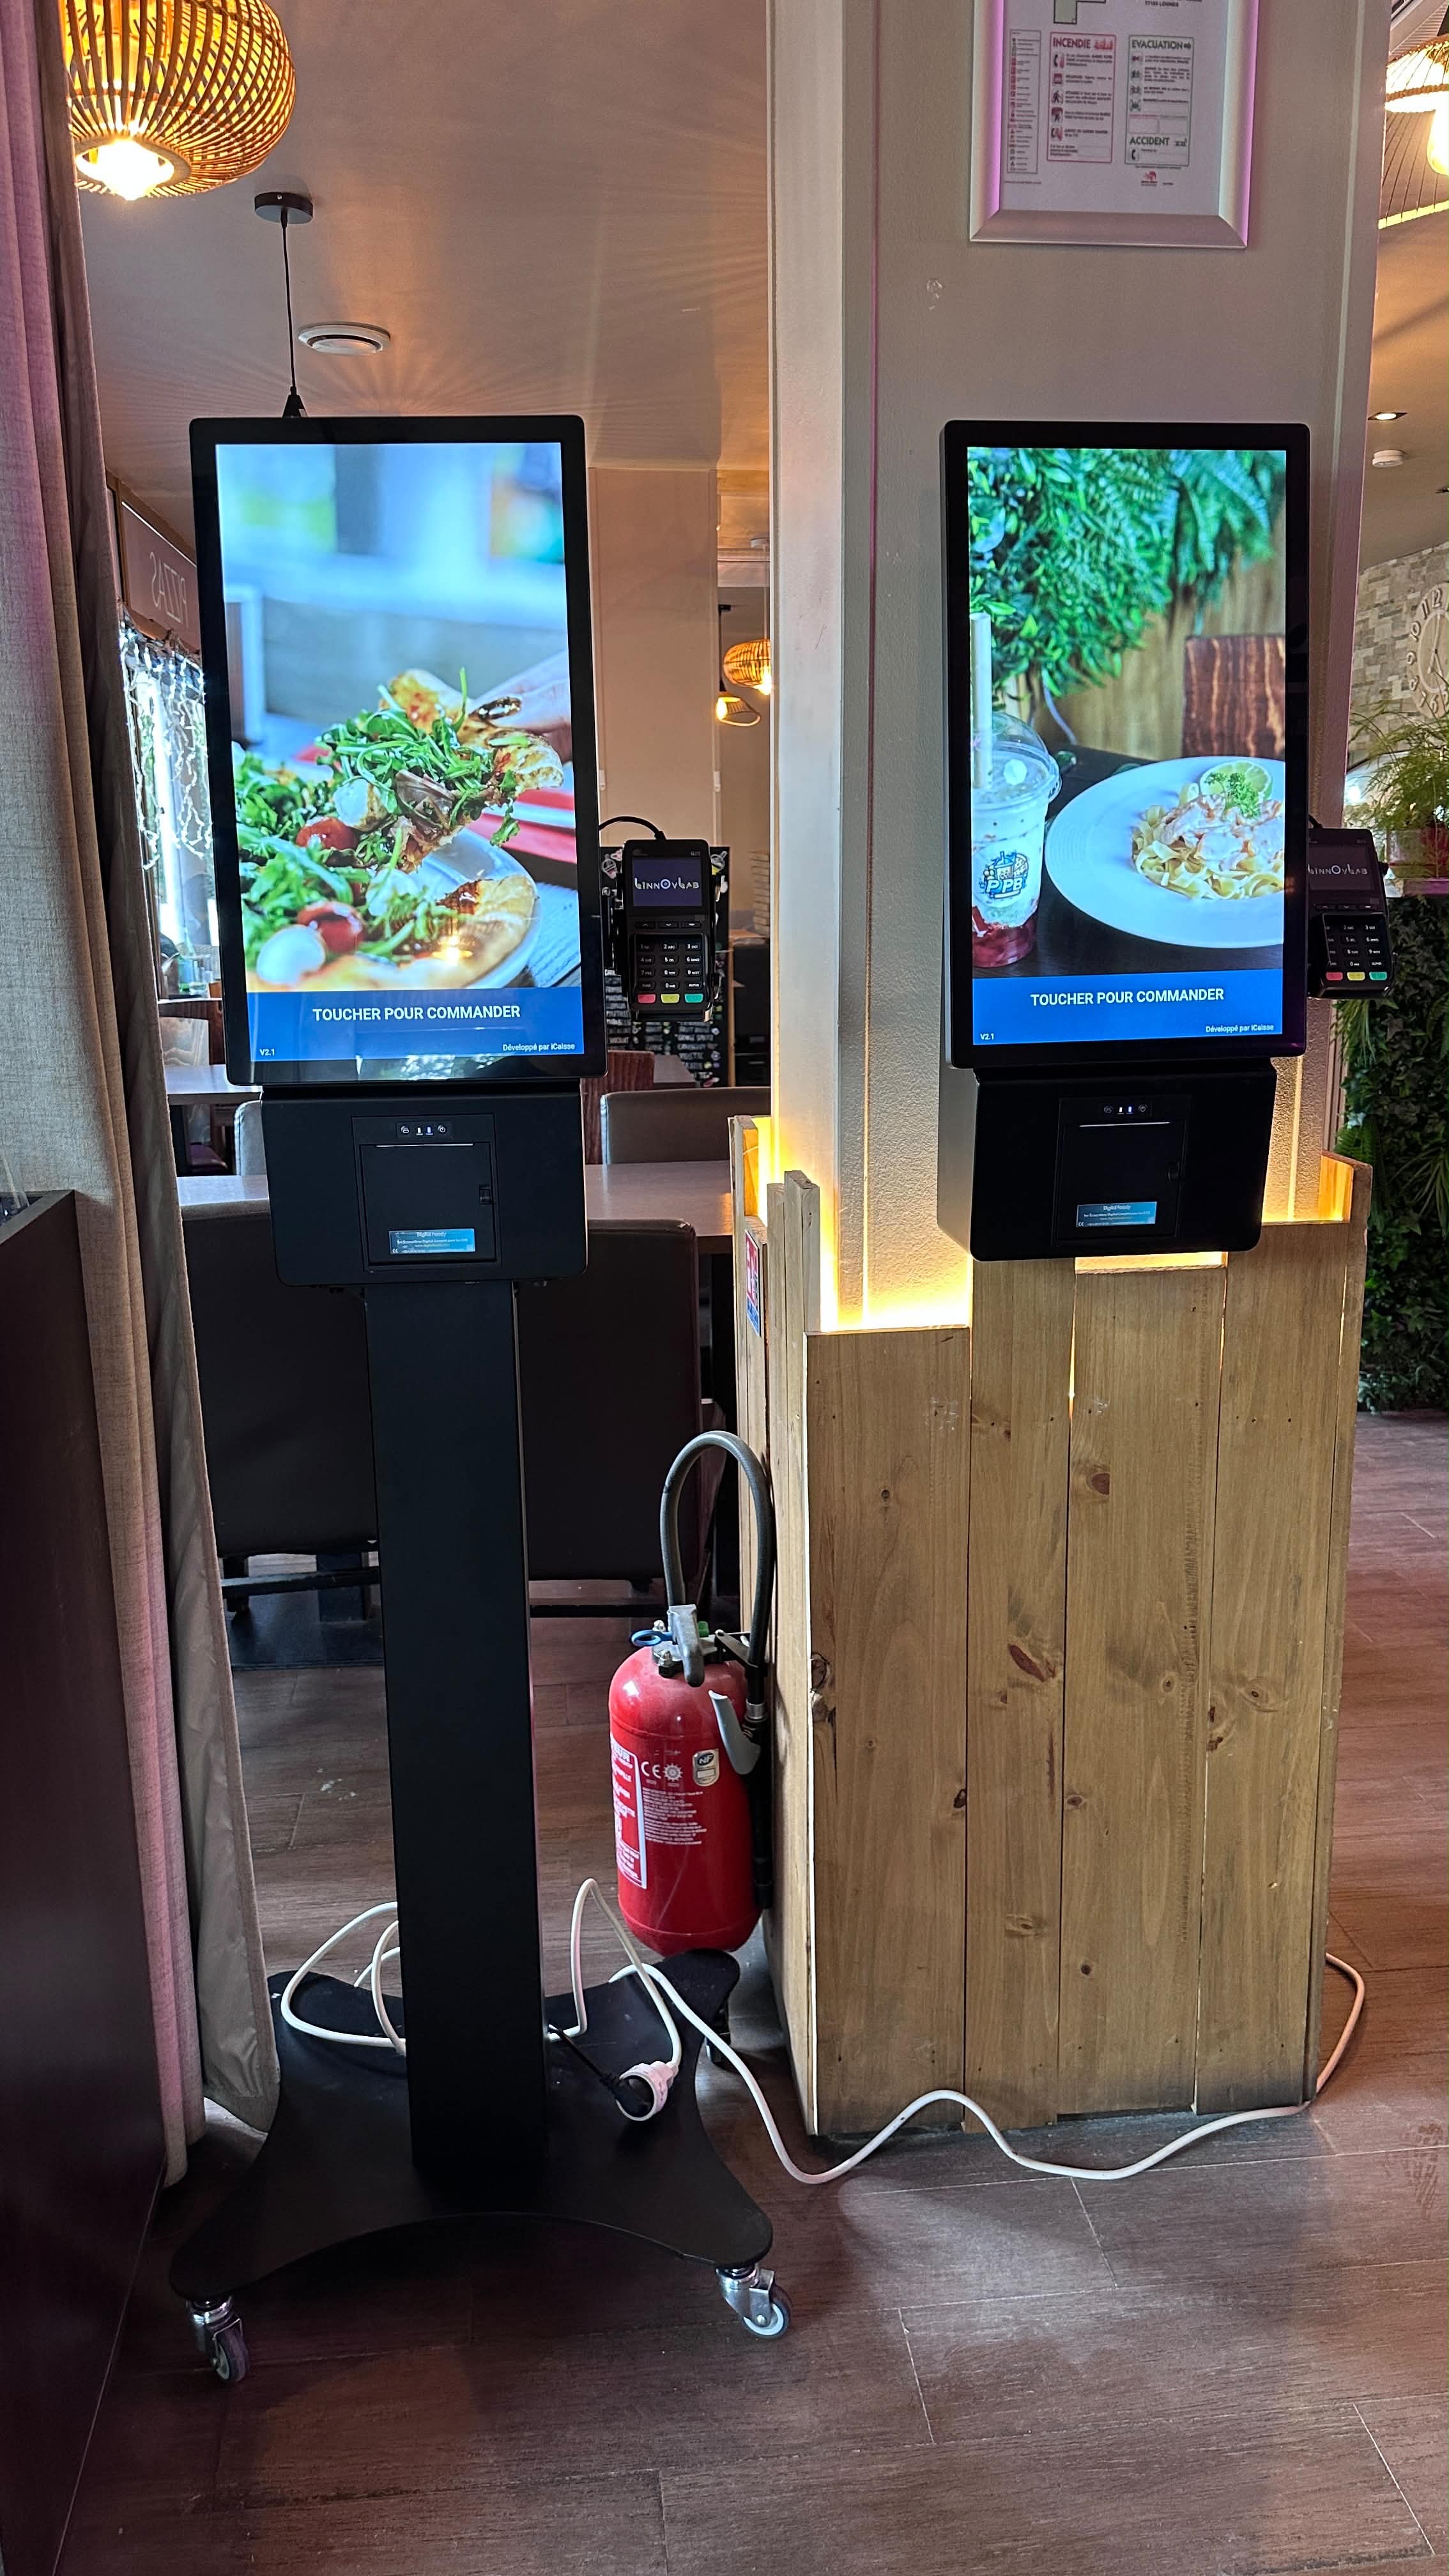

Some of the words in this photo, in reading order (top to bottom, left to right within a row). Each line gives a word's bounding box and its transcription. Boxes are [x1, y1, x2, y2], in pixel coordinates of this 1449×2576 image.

[1053, 37, 1091, 49] INCENDIE
[1131, 40, 1183, 50] EVACUATION
[1130, 137, 1170, 146] ACCIDENT
[1432, 587, 1443, 608] 12
[1030, 992, 1094, 1006] TOUCHER
[1097, 991, 1133, 1004] POUR
[1136, 988, 1224, 1002] COMMANDER
[312, 1008, 381, 1021] TOUCHER
[385, 1006, 424, 1020] POUR
[427, 1005, 521, 1019] COMMANDER
[1206, 1024, 1238, 1034] Développé
[503, 1043, 537, 1052] Développé
[699, 1754, 713, 1765] NF
[641, 1761, 662, 1779] CE
